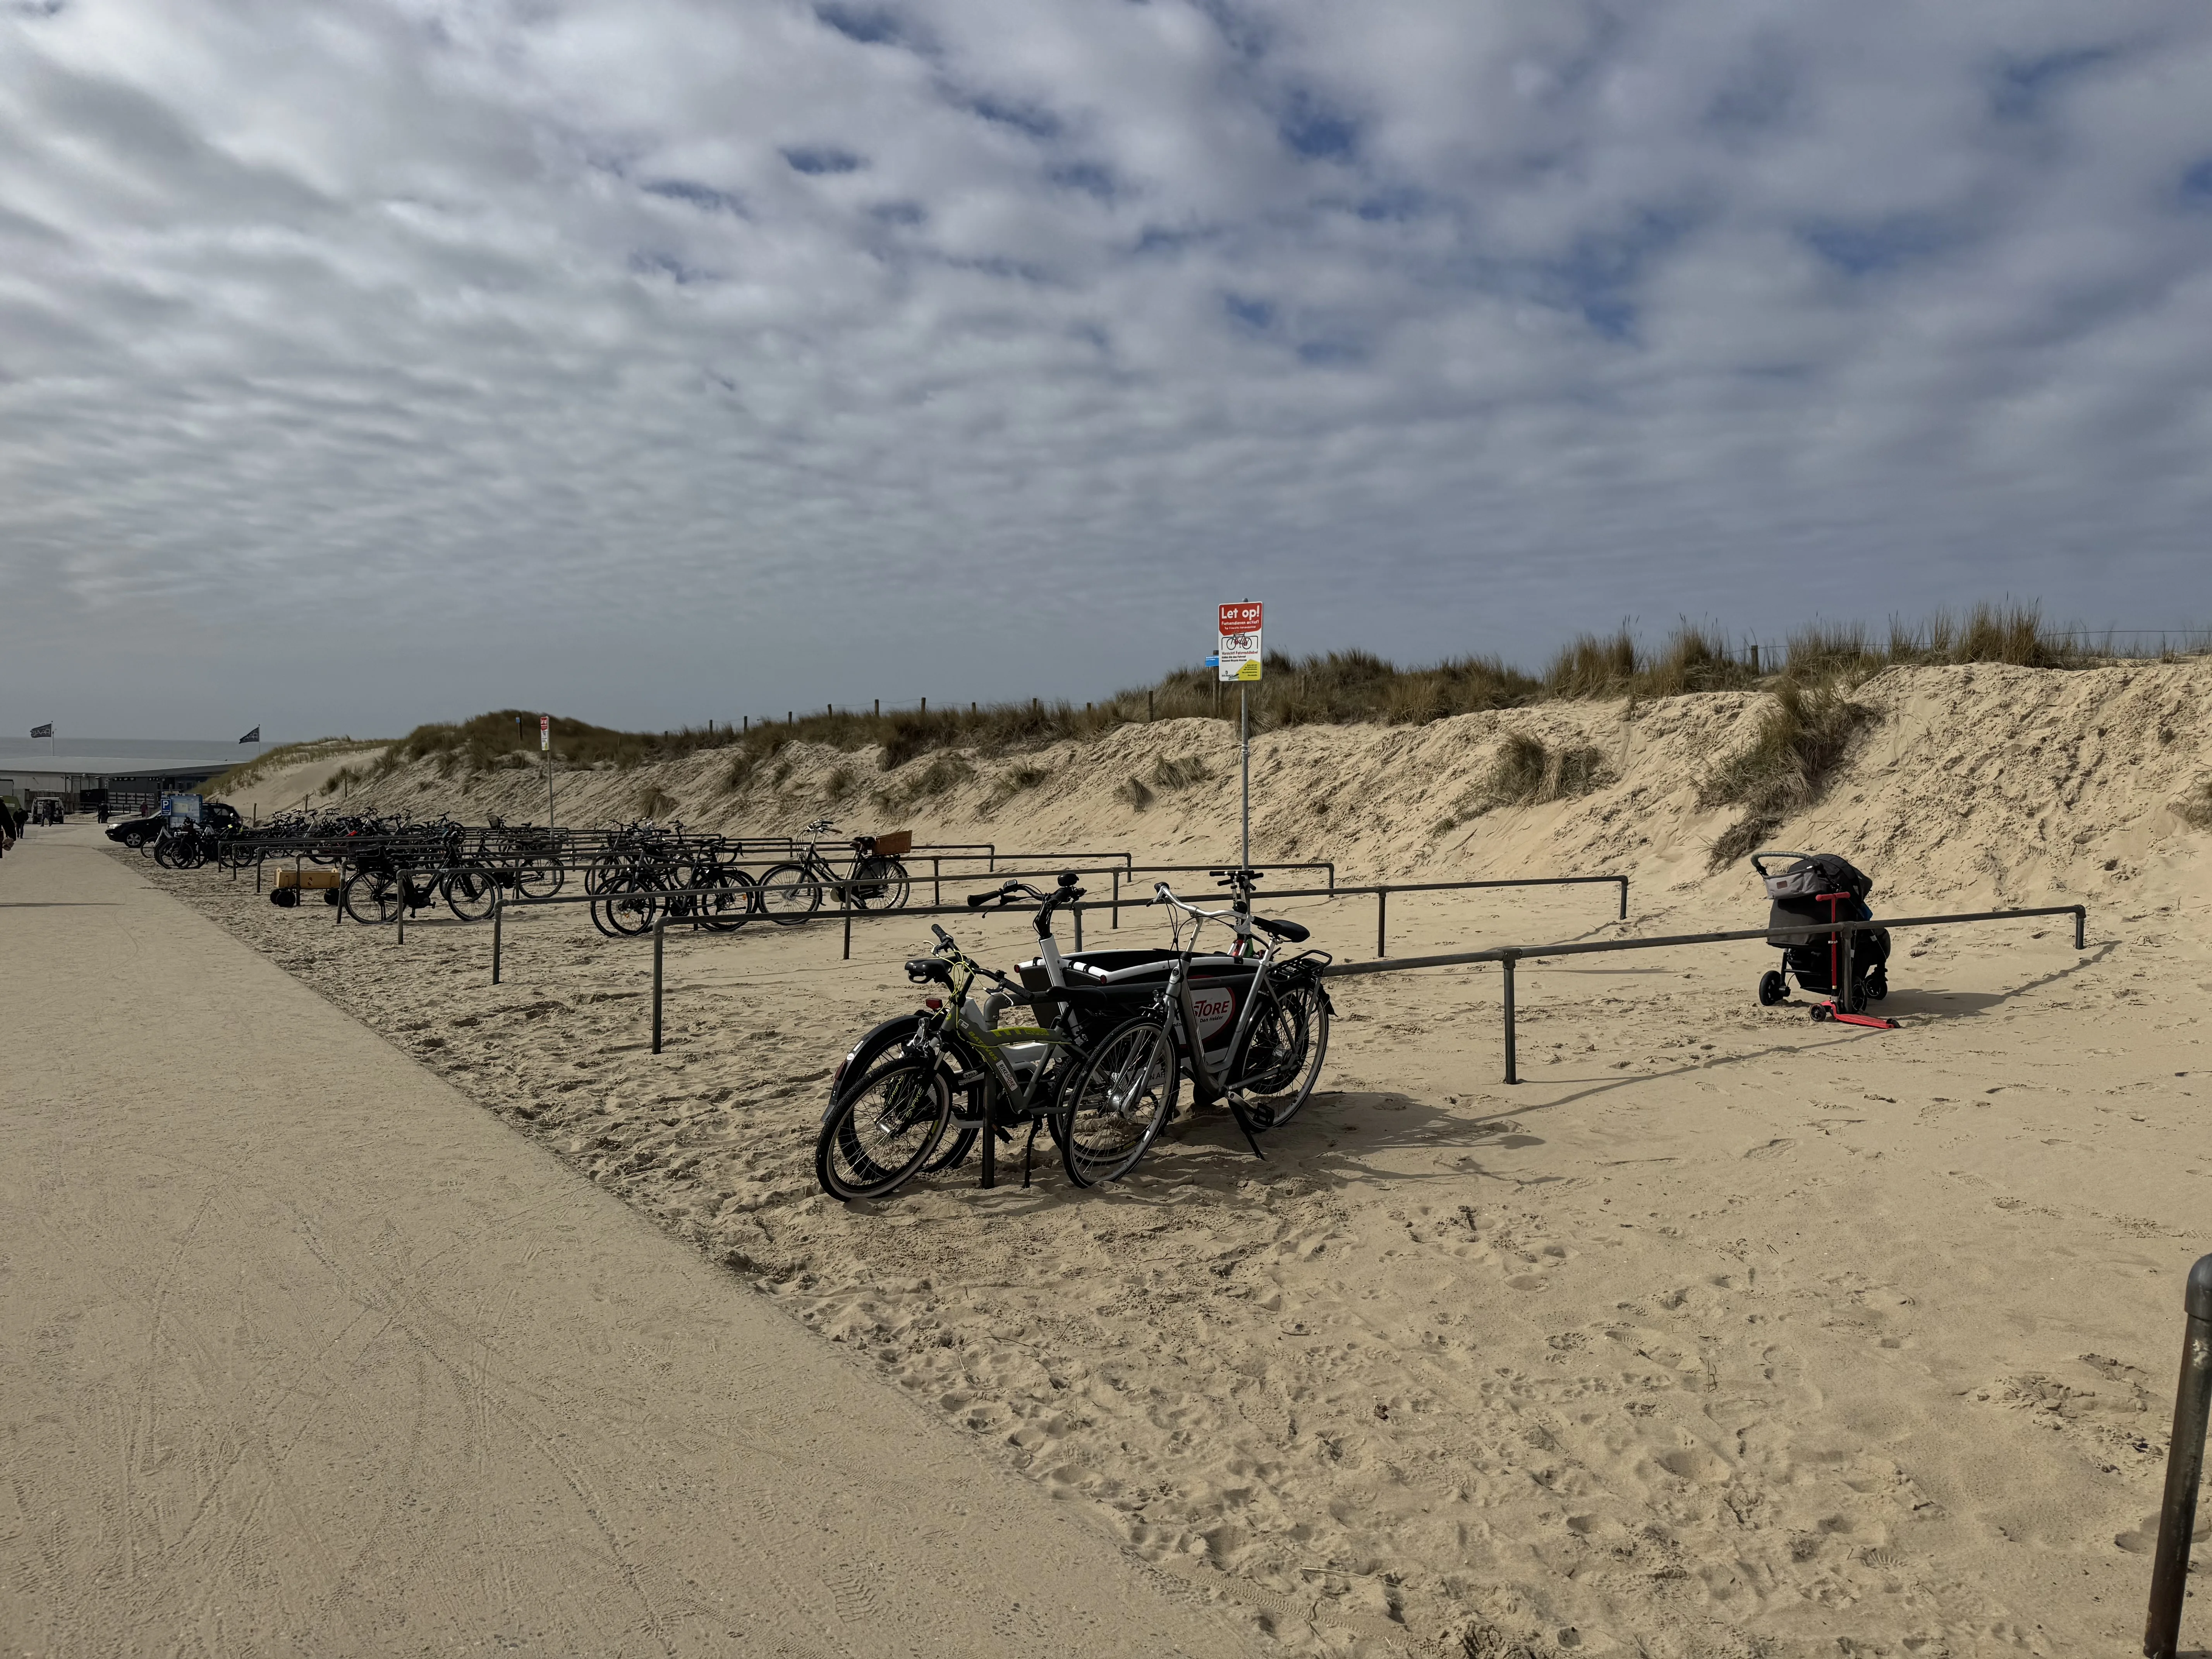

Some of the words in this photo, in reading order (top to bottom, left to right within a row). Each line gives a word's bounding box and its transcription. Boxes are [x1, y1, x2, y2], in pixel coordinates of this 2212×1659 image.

[1221, 607, 1238, 619] Let
[1242, 605, 1260, 620] op!
[163, 800, 169, 809] P
[999, 1063, 1015, 1087] BIKESTORE
[906, 1086, 924, 1118] SNAKE
